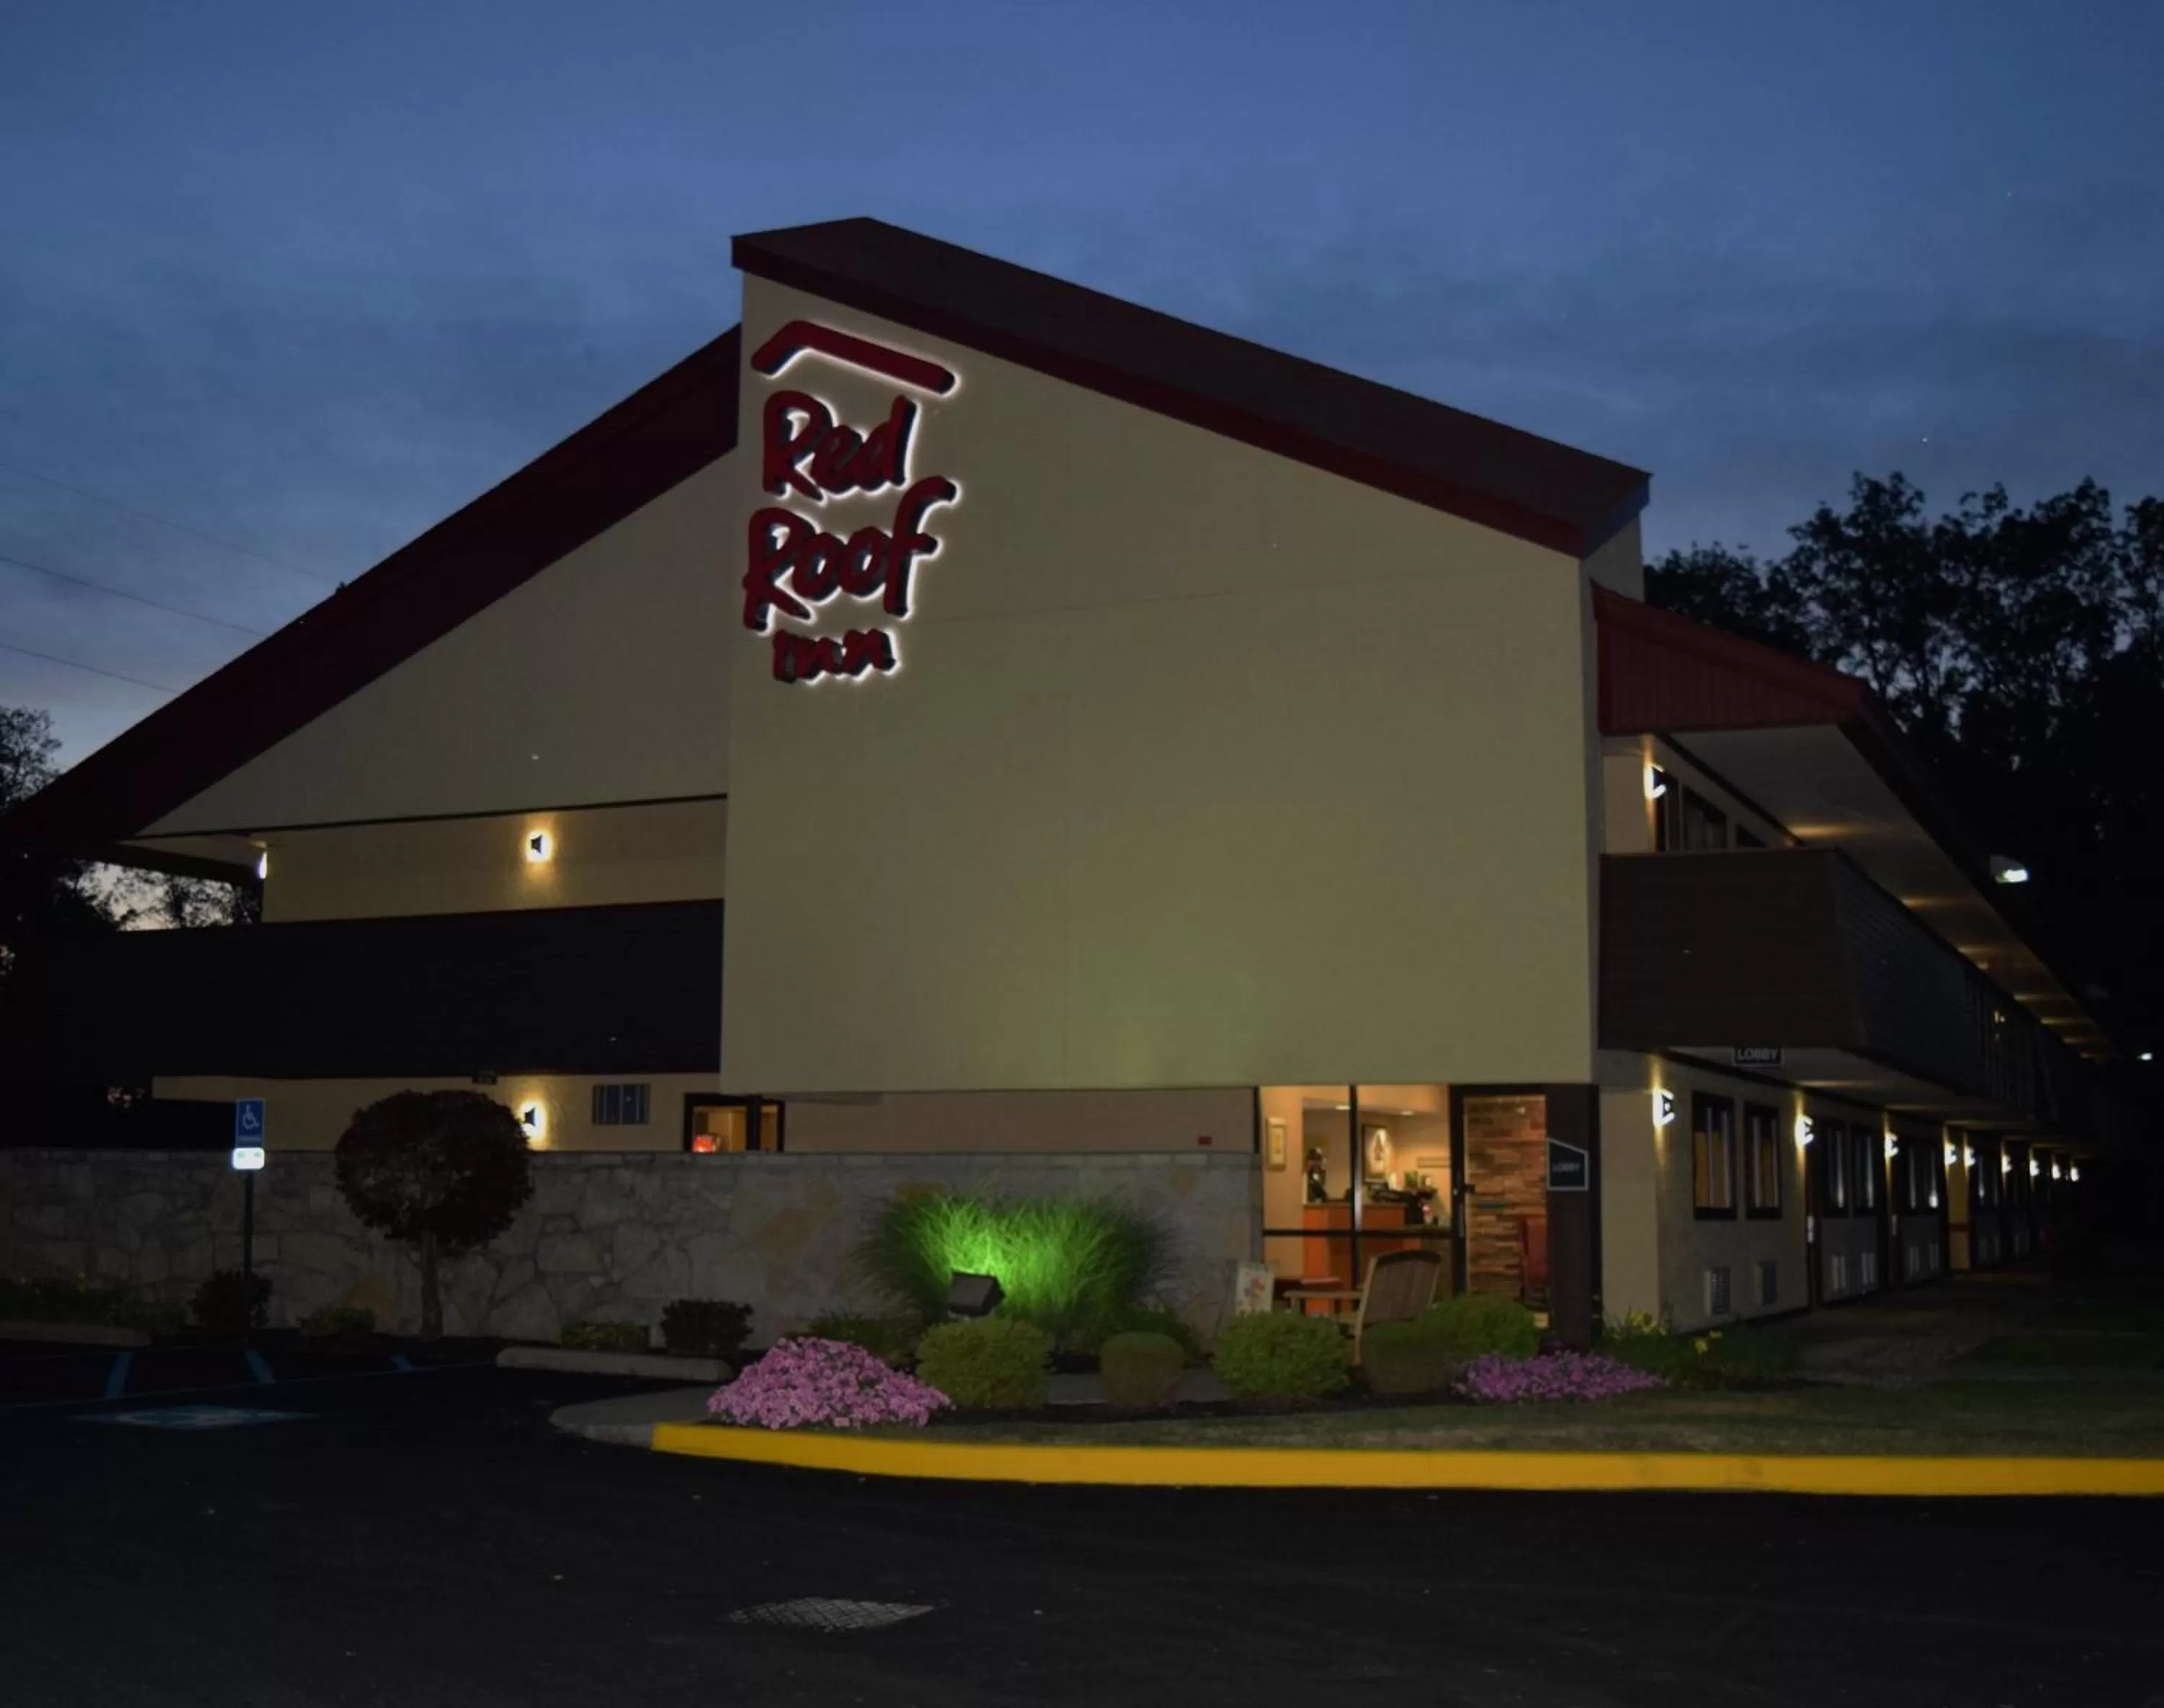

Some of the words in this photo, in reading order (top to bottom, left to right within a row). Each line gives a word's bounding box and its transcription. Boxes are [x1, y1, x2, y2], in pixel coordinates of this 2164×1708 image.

[762, 390, 916, 501] Red
[743, 475, 956, 631] Roof
[1736, 1047, 1778, 1061] LOBBY
